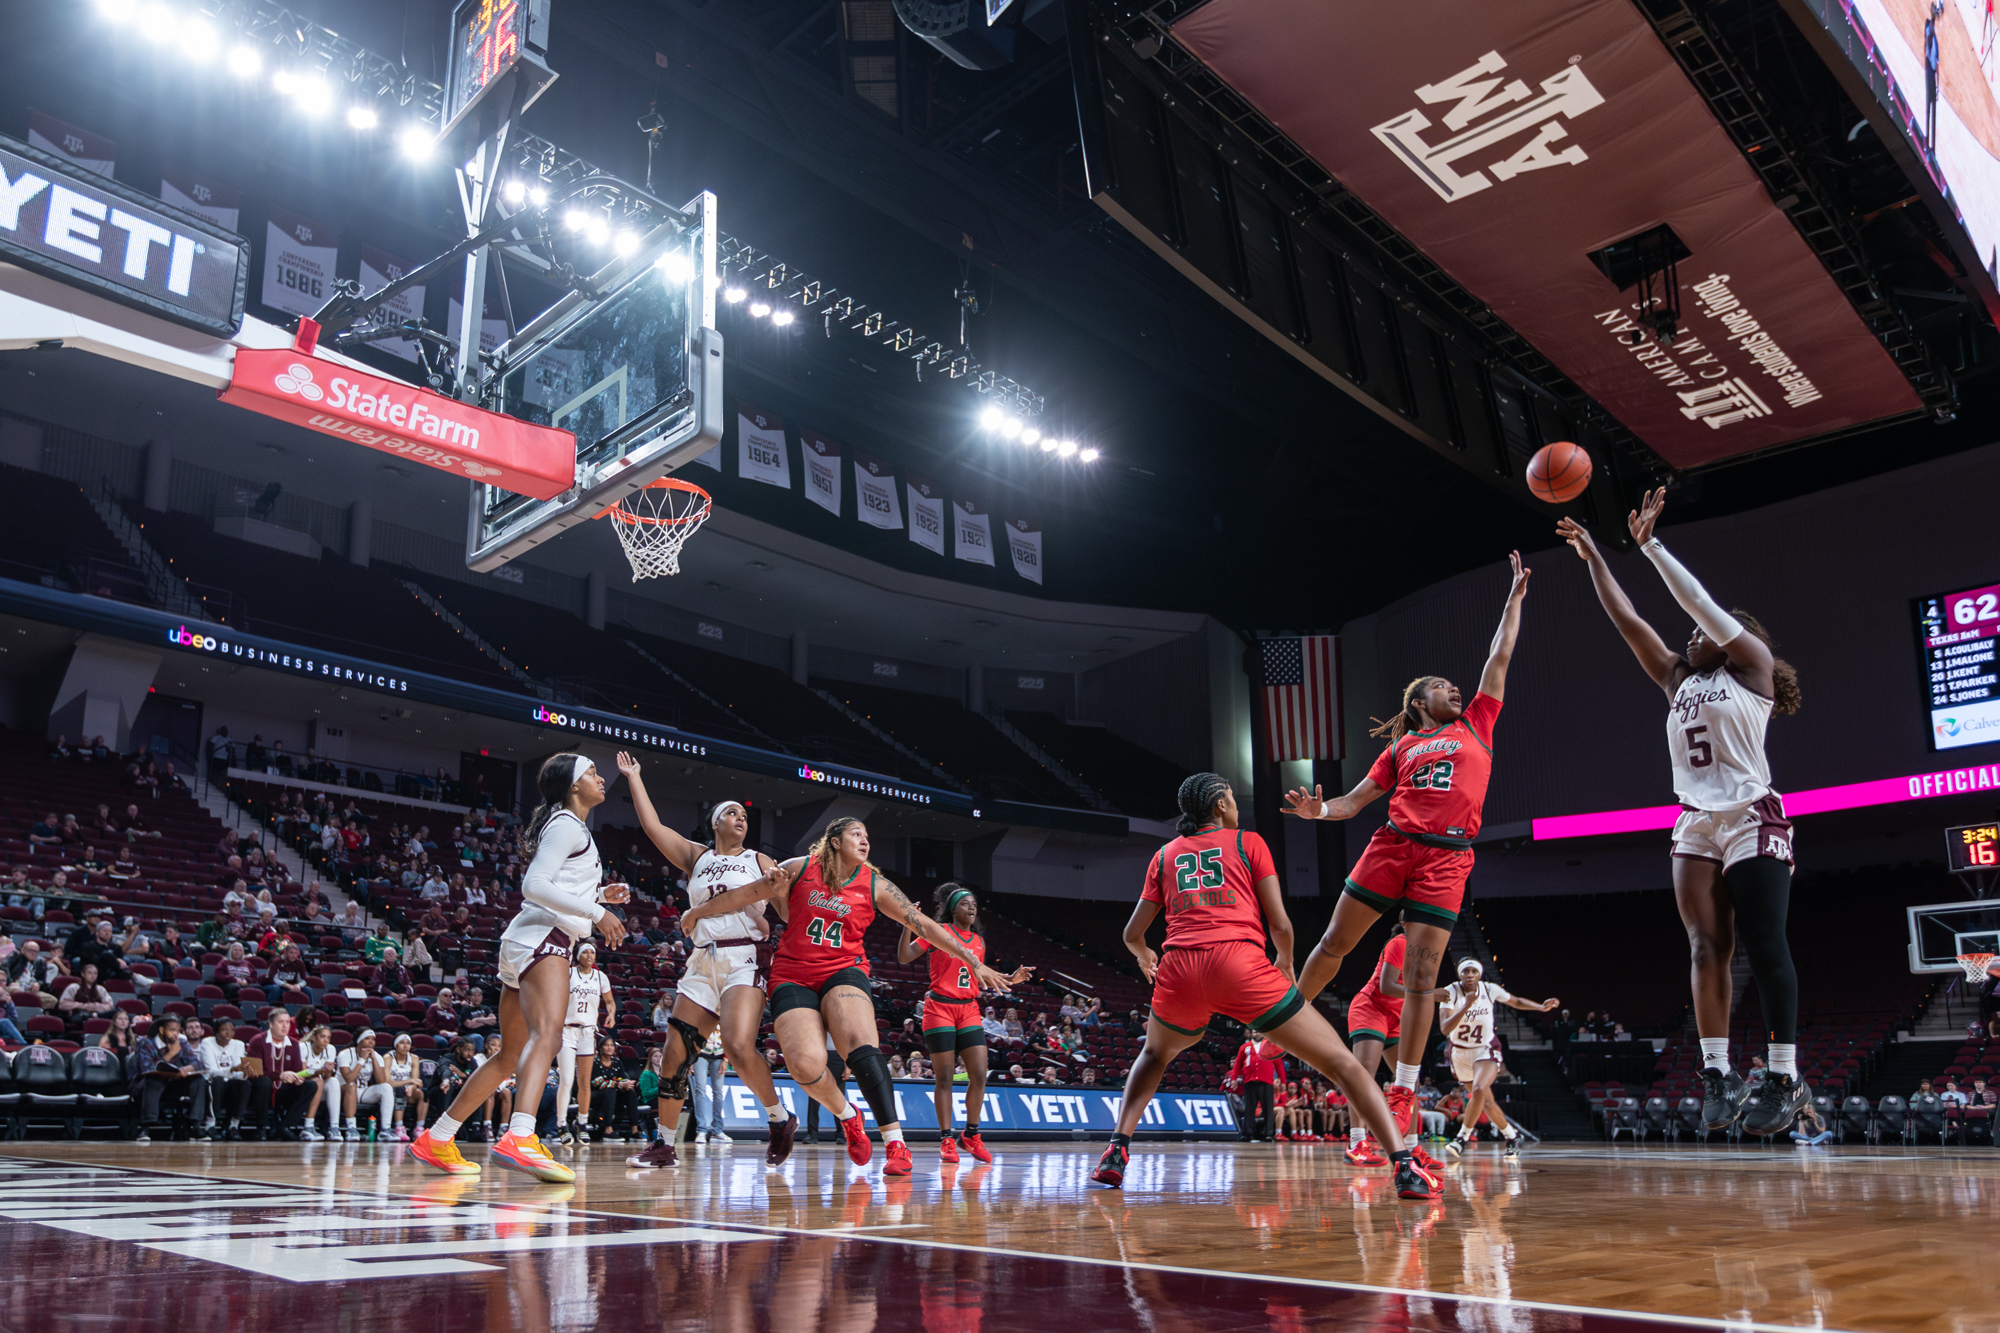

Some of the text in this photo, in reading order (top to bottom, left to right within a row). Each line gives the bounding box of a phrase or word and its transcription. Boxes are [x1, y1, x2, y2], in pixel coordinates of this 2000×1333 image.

[278, 255, 325, 278] CHAMPIONSHIP
[282, 250, 321, 270] CONFERENCE
[276, 264, 324, 299] 1986
[1721, 306, 1760, 340] love
[1740, 328, 1797, 376] students
[1778, 372, 1822, 408] Where
[748, 445, 781, 469] 1964
[811, 468, 834, 496] 1951
[862, 490, 892, 514] 1923
[915, 512, 939, 536] 1922
[961, 529, 987, 548] 1921
[1012, 546, 1038, 567] 1920
[1926, 605, 1939, 617] 4
[1953, 593, 1999, 625] 62
[698, 623, 724, 640] 223
[1928, 625, 1941, 637] 3
[1929, 632, 1960, 646] TEXAS
[169, 625, 408, 693] ubeo BUSINESS SERVICES
[1933, 638, 1995, 659] 5 A.COULIBALY
[1930, 651, 1995, 671] 13 J.MALONE
[1931, 665, 1981, 682] 20 J.KENT
[1932, 674, 1998, 694] 21 T.PARKER
[1672, 687, 1731, 723] Aggies
[1933, 688, 1990, 706] 24 S.JONES
[532, 705, 707, 757] ubeo BUSINESS SERVICES
[1406, 737, 1463, 762] Valley
[1685, 724, 1714, 769] 5
[798, 764, 932, 805] ubeo BUSINESS SERVICES
[1410, 759, 1455, 792] 22
[1908, 765, 2000, 798] OFFICIAL
[1962, 827, 1998, 844] 3:24
[1969, 841, 1996, 865] 16
[697, 861, 749, 883] Aggies
[1174, 846, 1225, 894] 25
[808, 889, 853, 918] Valley
[806, 916, 844, 948] 44
[957, 966, 972, 990] 2
[570, 985, 599, 1000] Aggies
[577, 1001, 589, 1014] 21
[1464, 1006, 1490, 1023] ggies
[1457, 1024, 1484, 1045] 24
[1018, 1094, 1090, 1124] YETI
[1175, 1098, 1234, 1126] YETI
